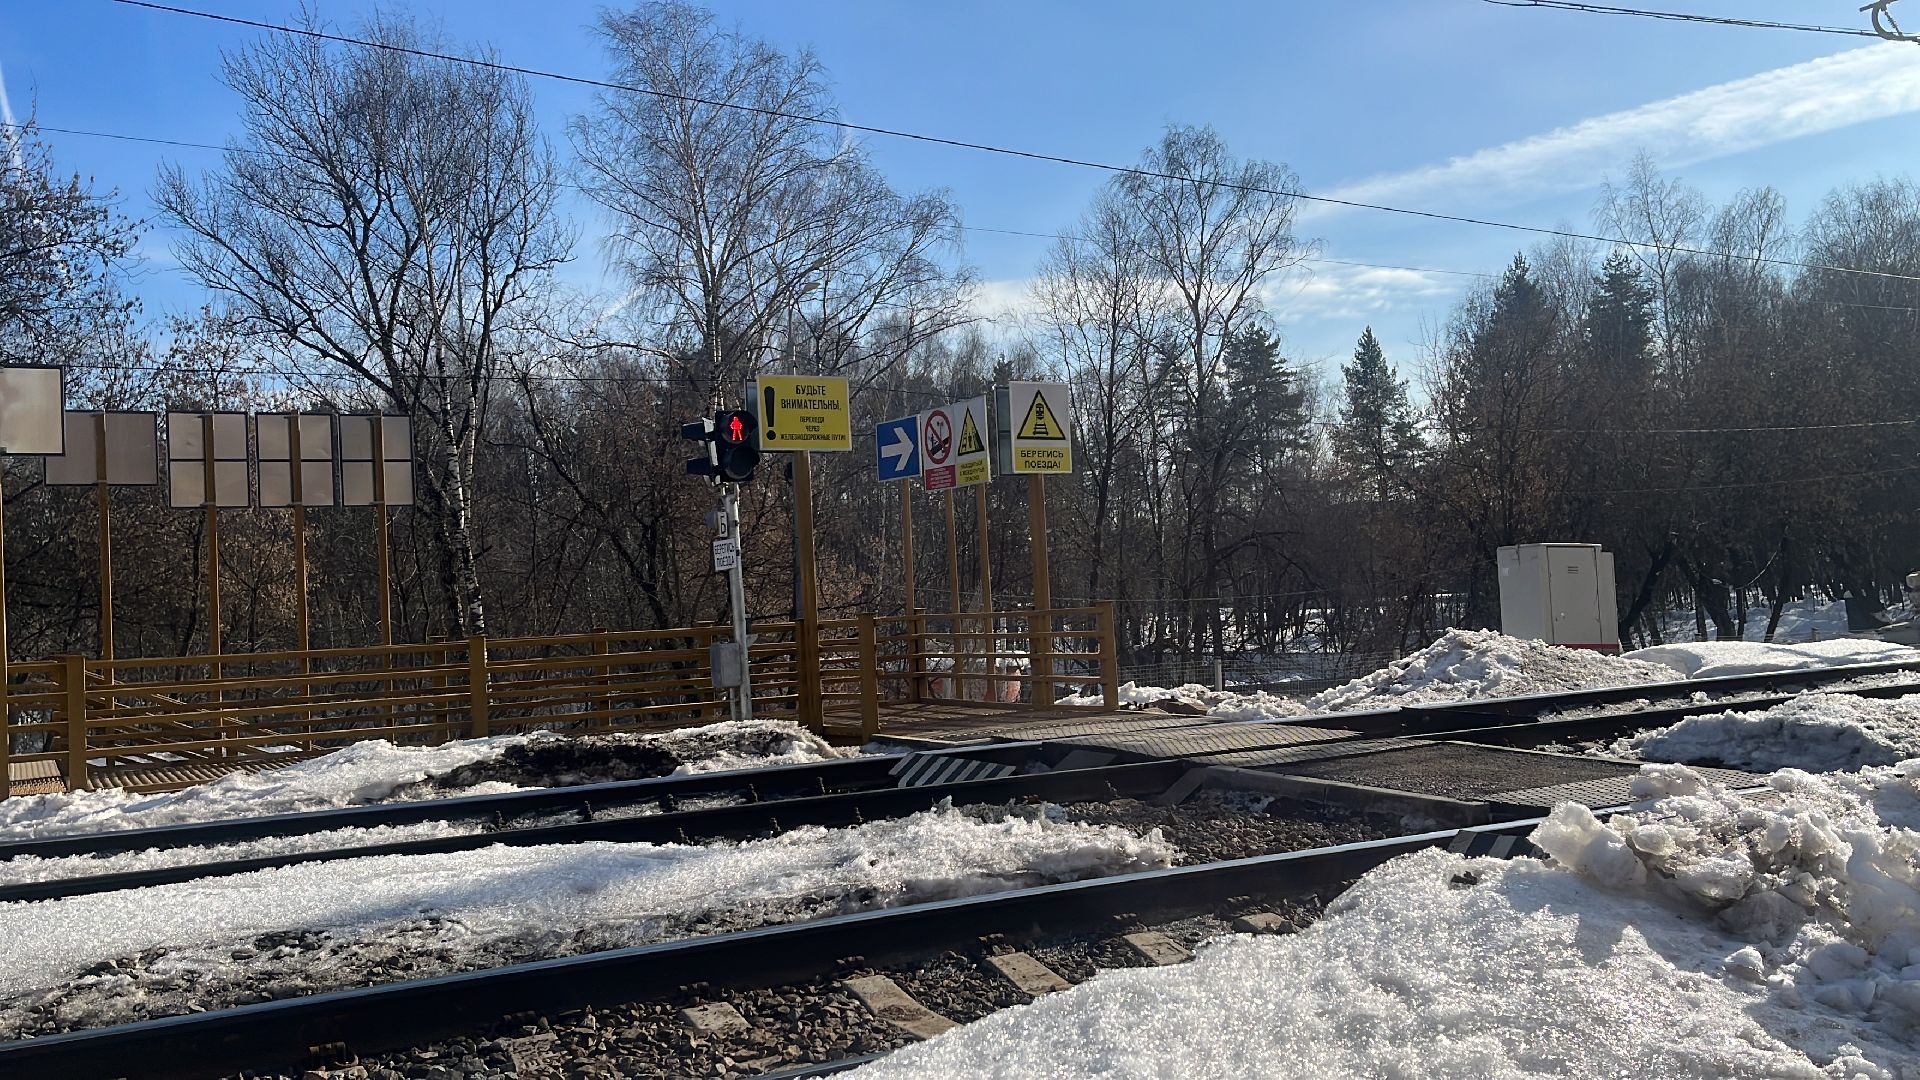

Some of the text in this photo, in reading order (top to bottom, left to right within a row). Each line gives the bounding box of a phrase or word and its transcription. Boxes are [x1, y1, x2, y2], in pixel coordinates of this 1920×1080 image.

[795, 384, 826, 396] БУДЬТЕ
[781, 398, 842, 411] ВНИМАТЕЛЬНЫ,
[1020, 450, 1064, 458] БЕРЕГИСЬ
[1024, 460, 1061, 469] ПОЕЗДА!
